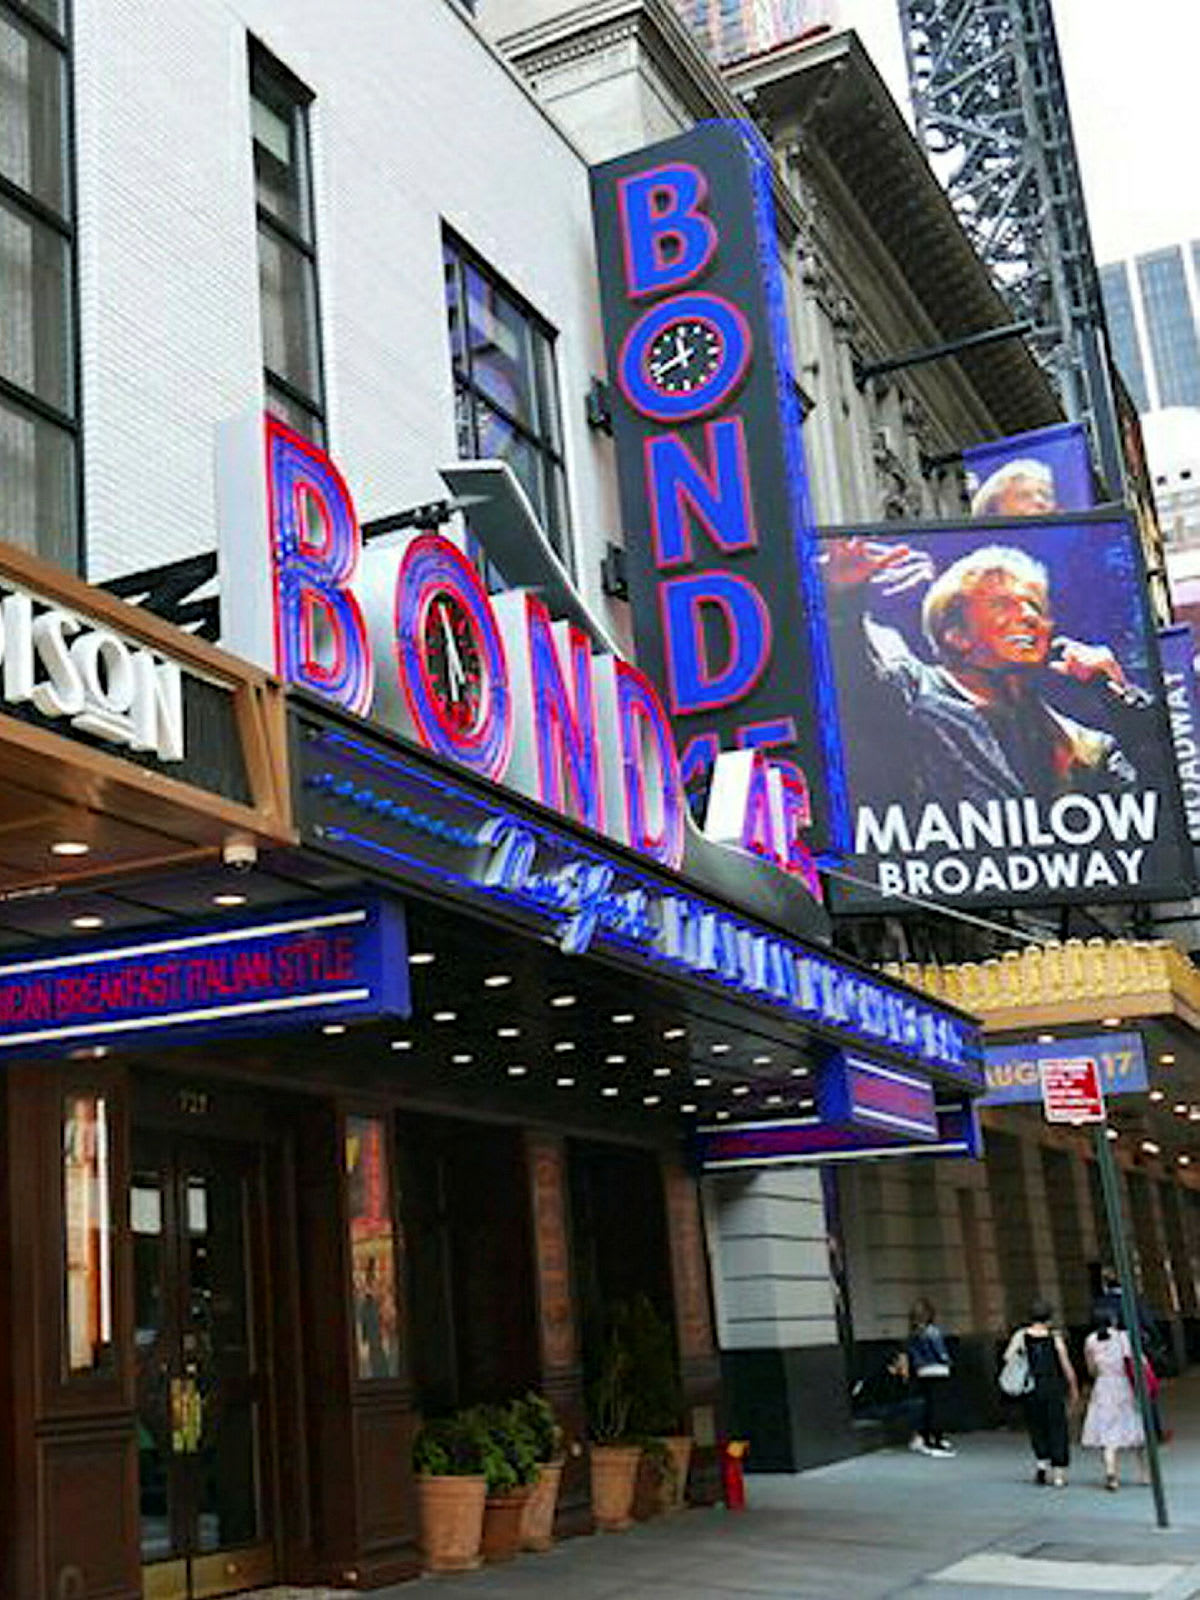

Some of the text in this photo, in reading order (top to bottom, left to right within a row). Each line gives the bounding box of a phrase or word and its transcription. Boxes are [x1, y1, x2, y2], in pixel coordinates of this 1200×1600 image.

[617, 161, 772, 716] BOND
[264, 411, 683, 872] BOND
[855, 791, 1158, 854] MANILOW
[879, 850, 1144, 897] BROADWAY
[55, 961, 181, 1019] BREAKFAST
[187, 951, 271, 1001] ITALIAN
[275, 937, 356, 989] STYLE
